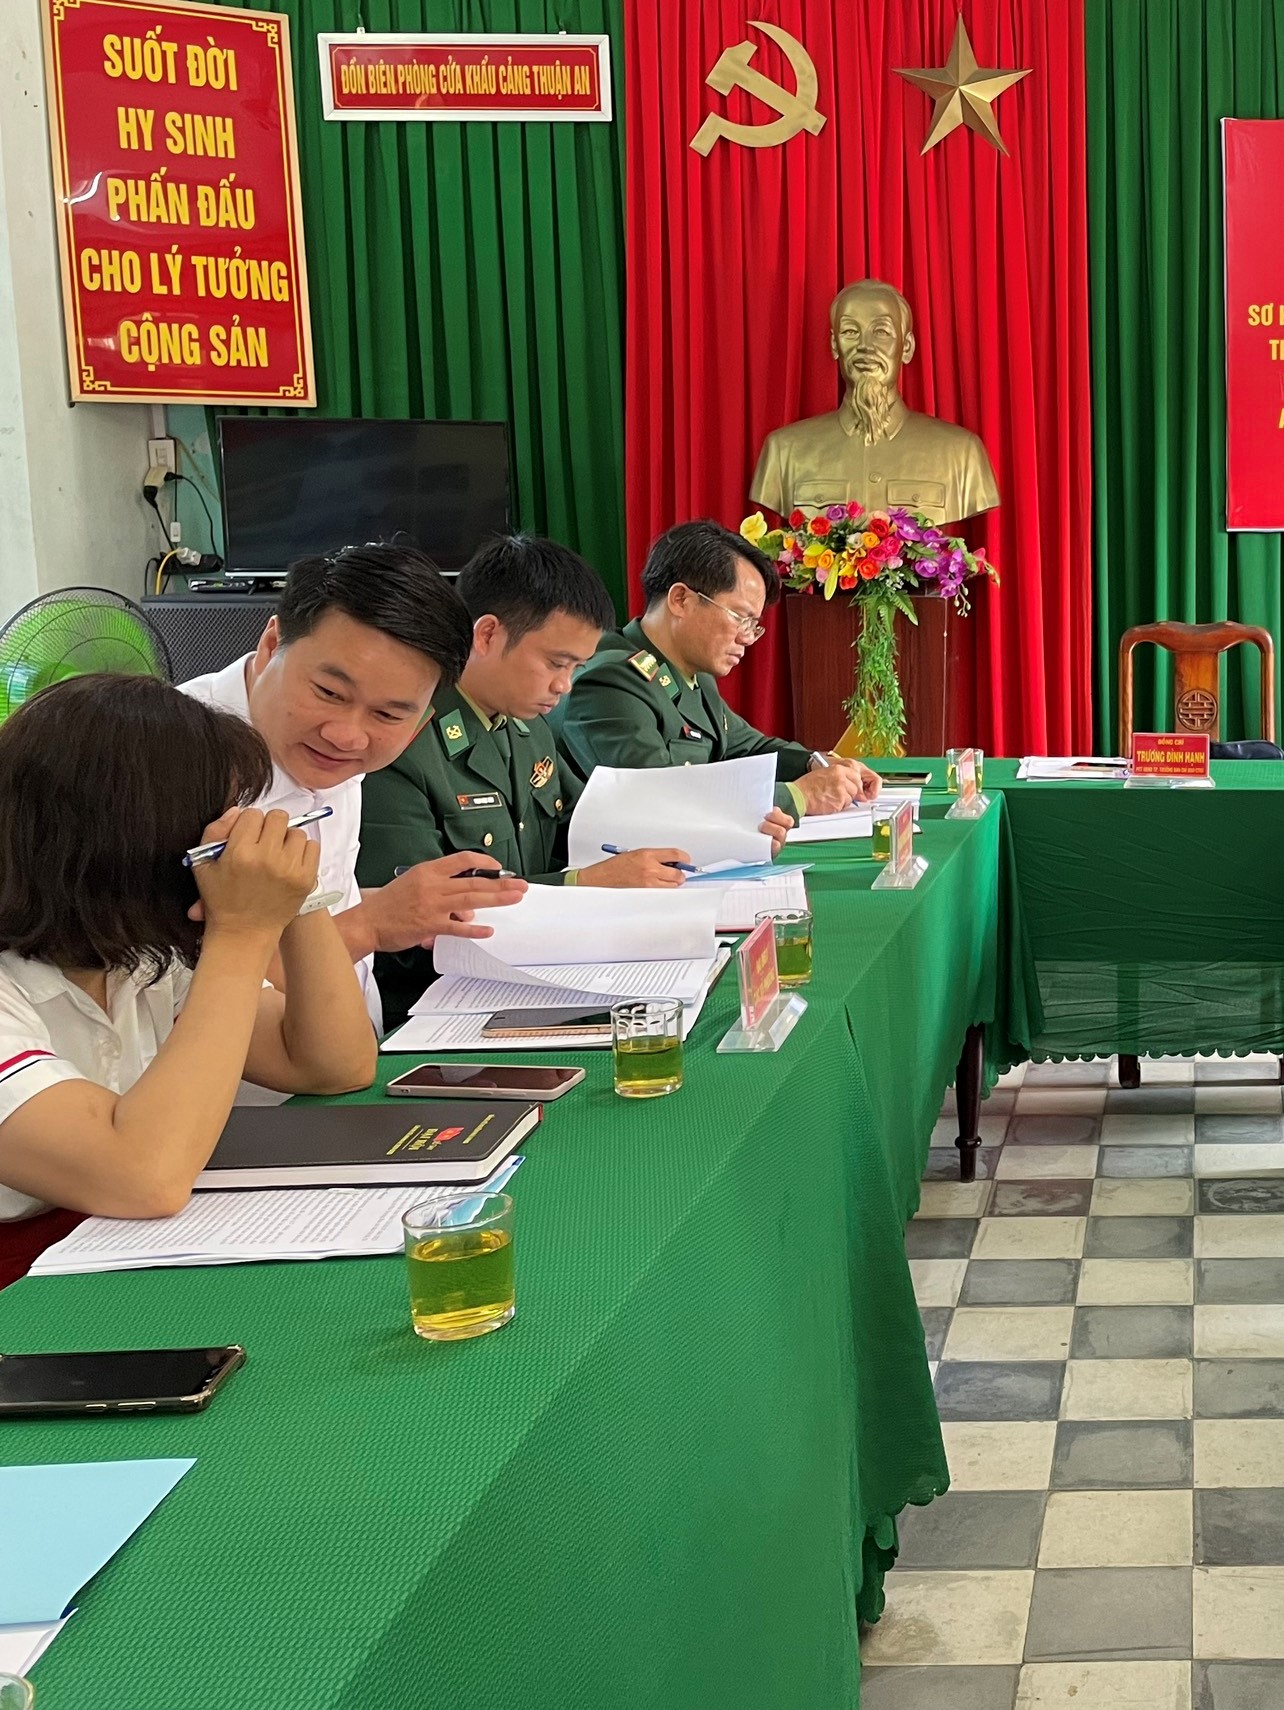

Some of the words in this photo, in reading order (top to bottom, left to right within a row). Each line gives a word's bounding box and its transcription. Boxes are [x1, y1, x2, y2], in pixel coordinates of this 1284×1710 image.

[103, 27, 178, 83] SUỐT
[187, 36, 237, 90] ĐỜI
[368, 59, 396, 94] BIÊN
[398, 59, 437, 94] PHÒNG
[439, 55, 463, 94] CỬA
[465, 55, 496, 94] KHẨU
[499, 56, 529, 94] CẢNG
[532, 60, 571, 99] THUẬN
[574, 66, 590, 95] AN
[117, 107, 154, 151] HY
[165, 112, 235, 158] SINH
[107, 167, 190, 225] PHẤN
[197, 173, 255, 229] ĐẤU
[81, 248, 141, 293] CHO
[150, 245, 182, 295] LÝ
[191, 246, 289, 302] TƯỞNG
[119, 312, 201, 371] CỘNG
[210, 315, 268, 367] SẢN
[1248, 303, 1273, 326] SƠ
[1185, 752, 1205, 766] HẠNH
